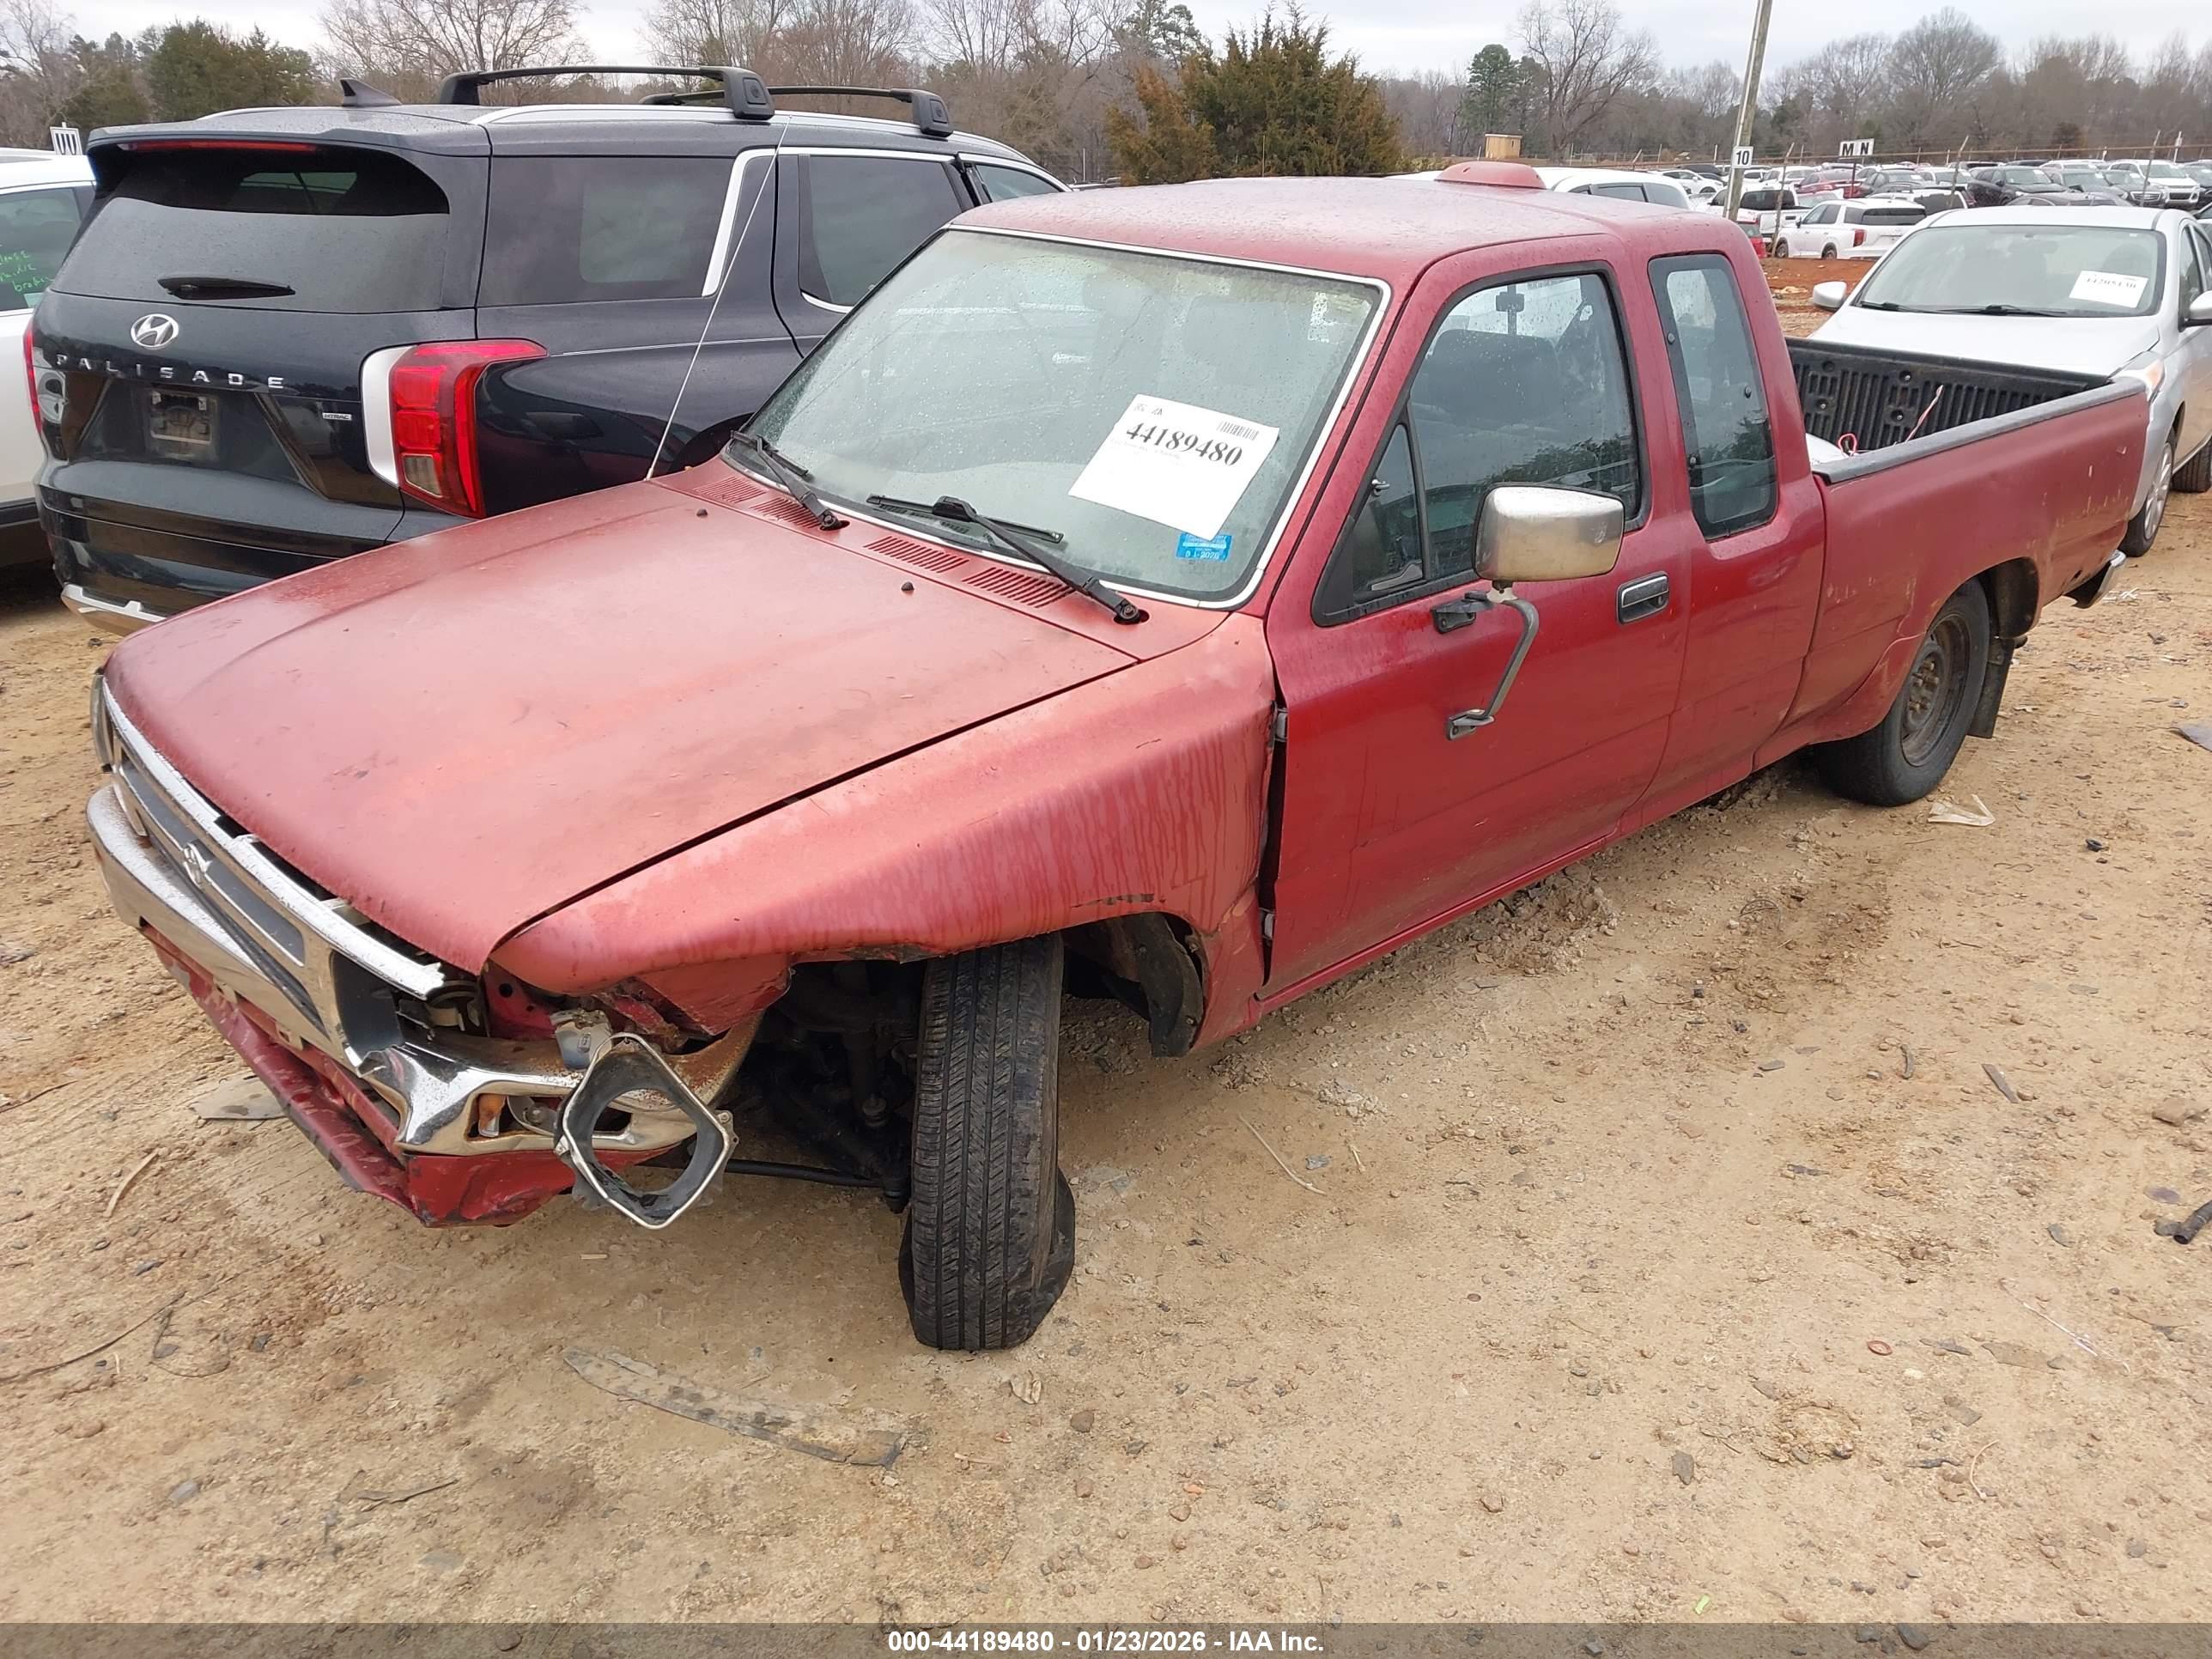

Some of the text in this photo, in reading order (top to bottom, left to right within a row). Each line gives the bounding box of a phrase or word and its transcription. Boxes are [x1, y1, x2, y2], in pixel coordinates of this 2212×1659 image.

[1735, 150, 1749, 166] 10
[1842, 142, 1869, 156] M N
[56, 353, 284, 389] PALISADE
[1127, 422, 1243, 466] 44189480
